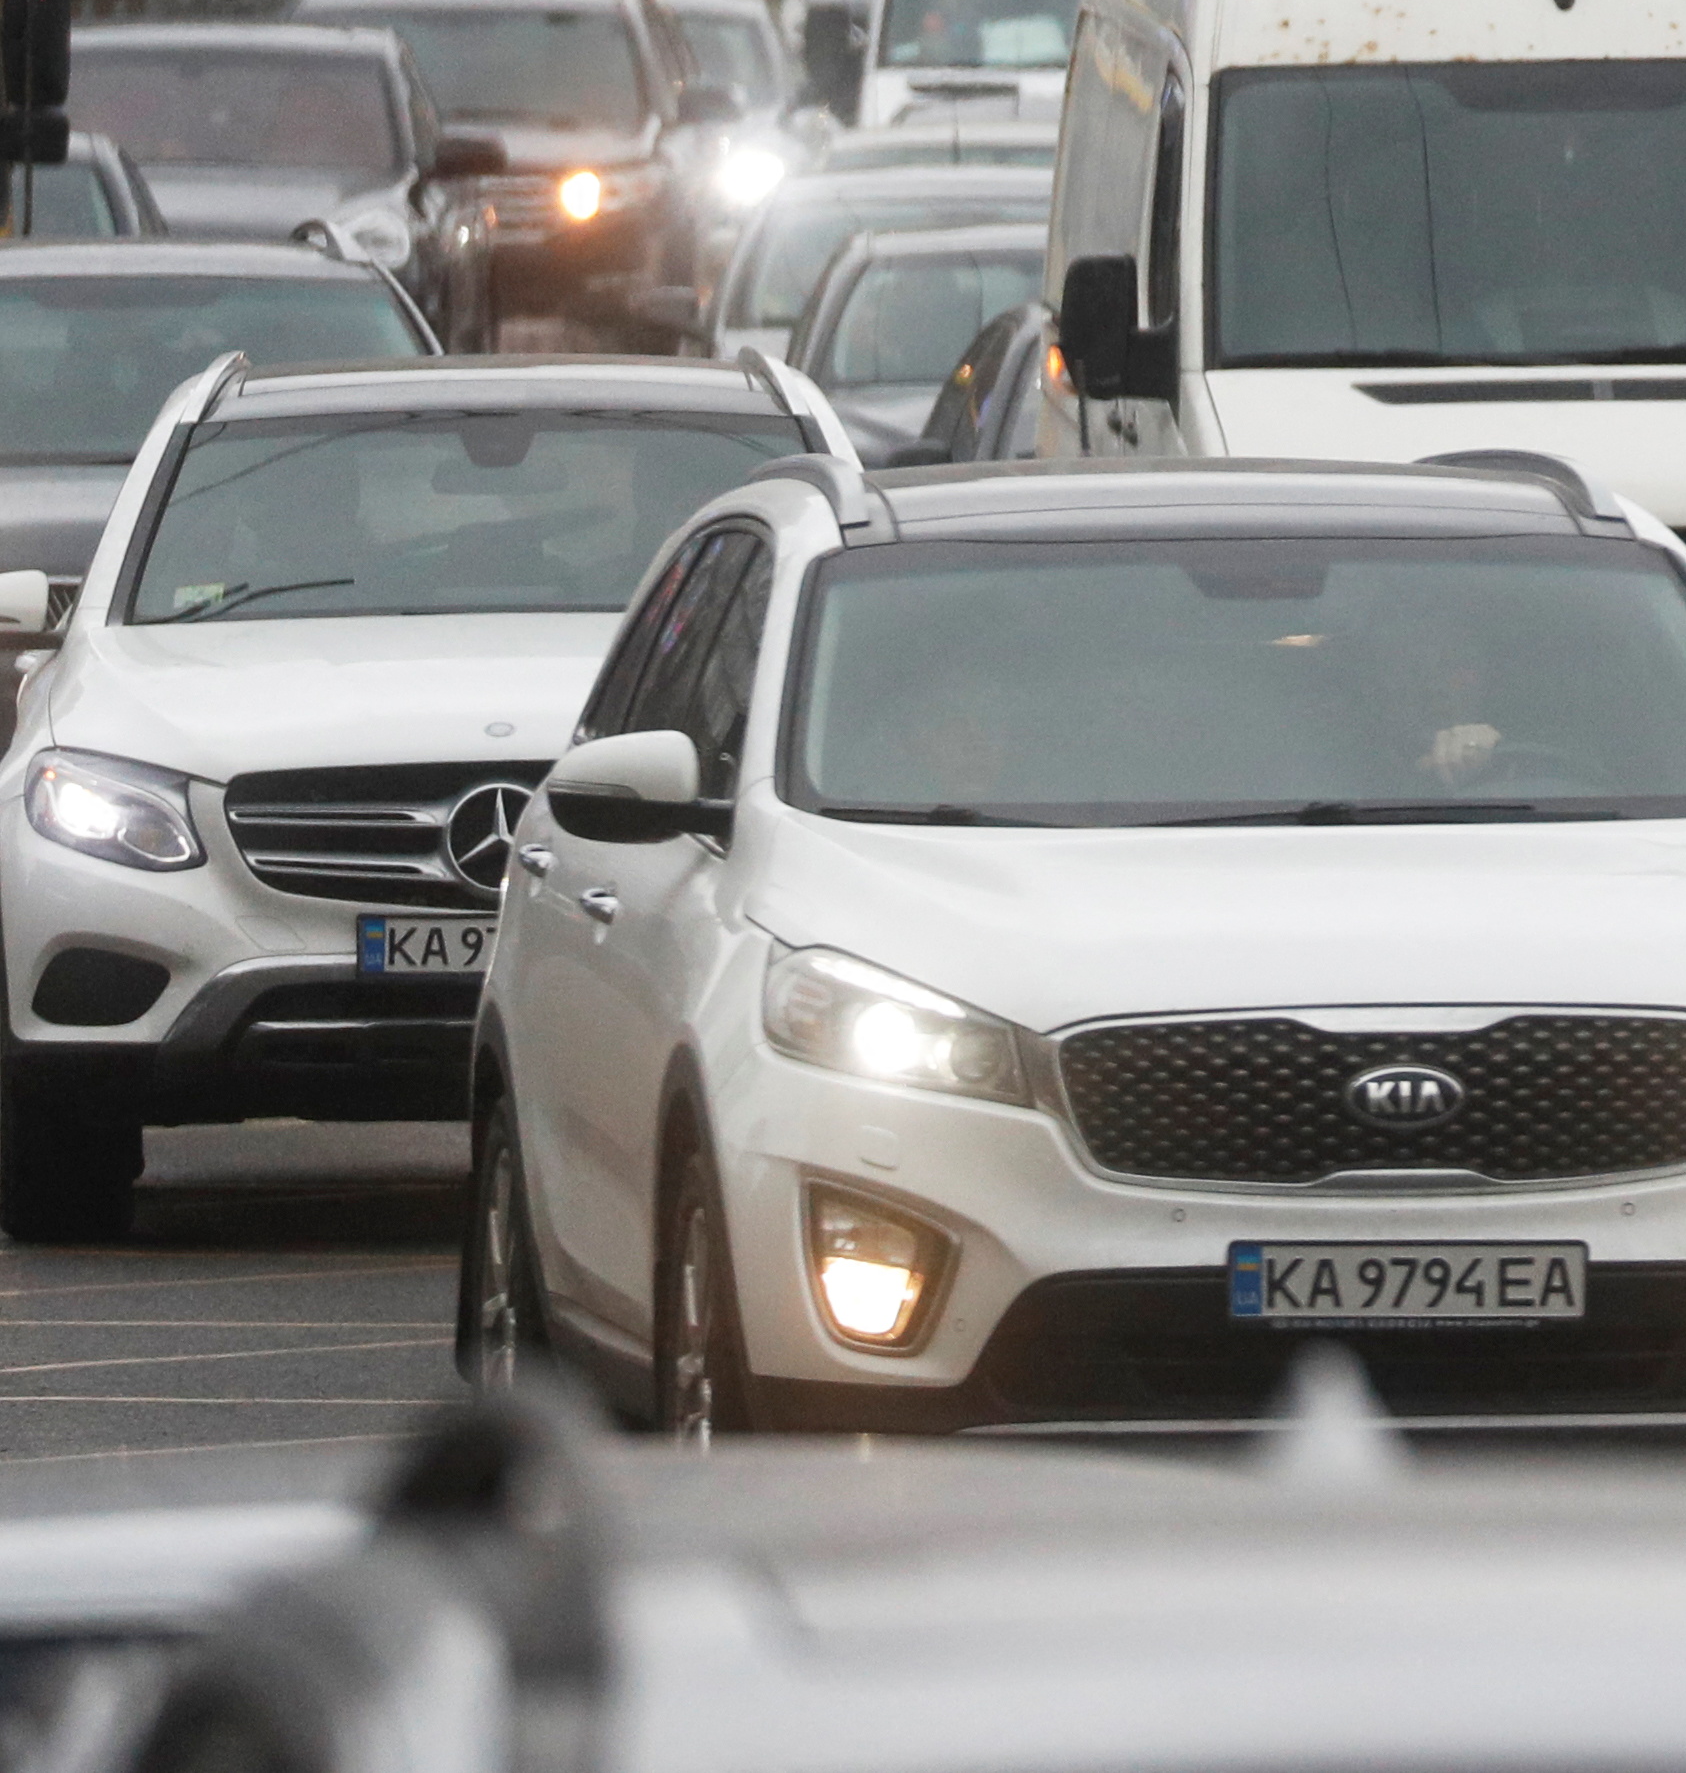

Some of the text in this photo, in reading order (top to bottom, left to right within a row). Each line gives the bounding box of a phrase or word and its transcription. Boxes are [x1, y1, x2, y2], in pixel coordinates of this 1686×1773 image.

[388, 927, 496, 966] KA 9
[1366, 1080, 1446, 1113] KIA
[1266, 1257, 1576, 1309] KA 9794 EA
